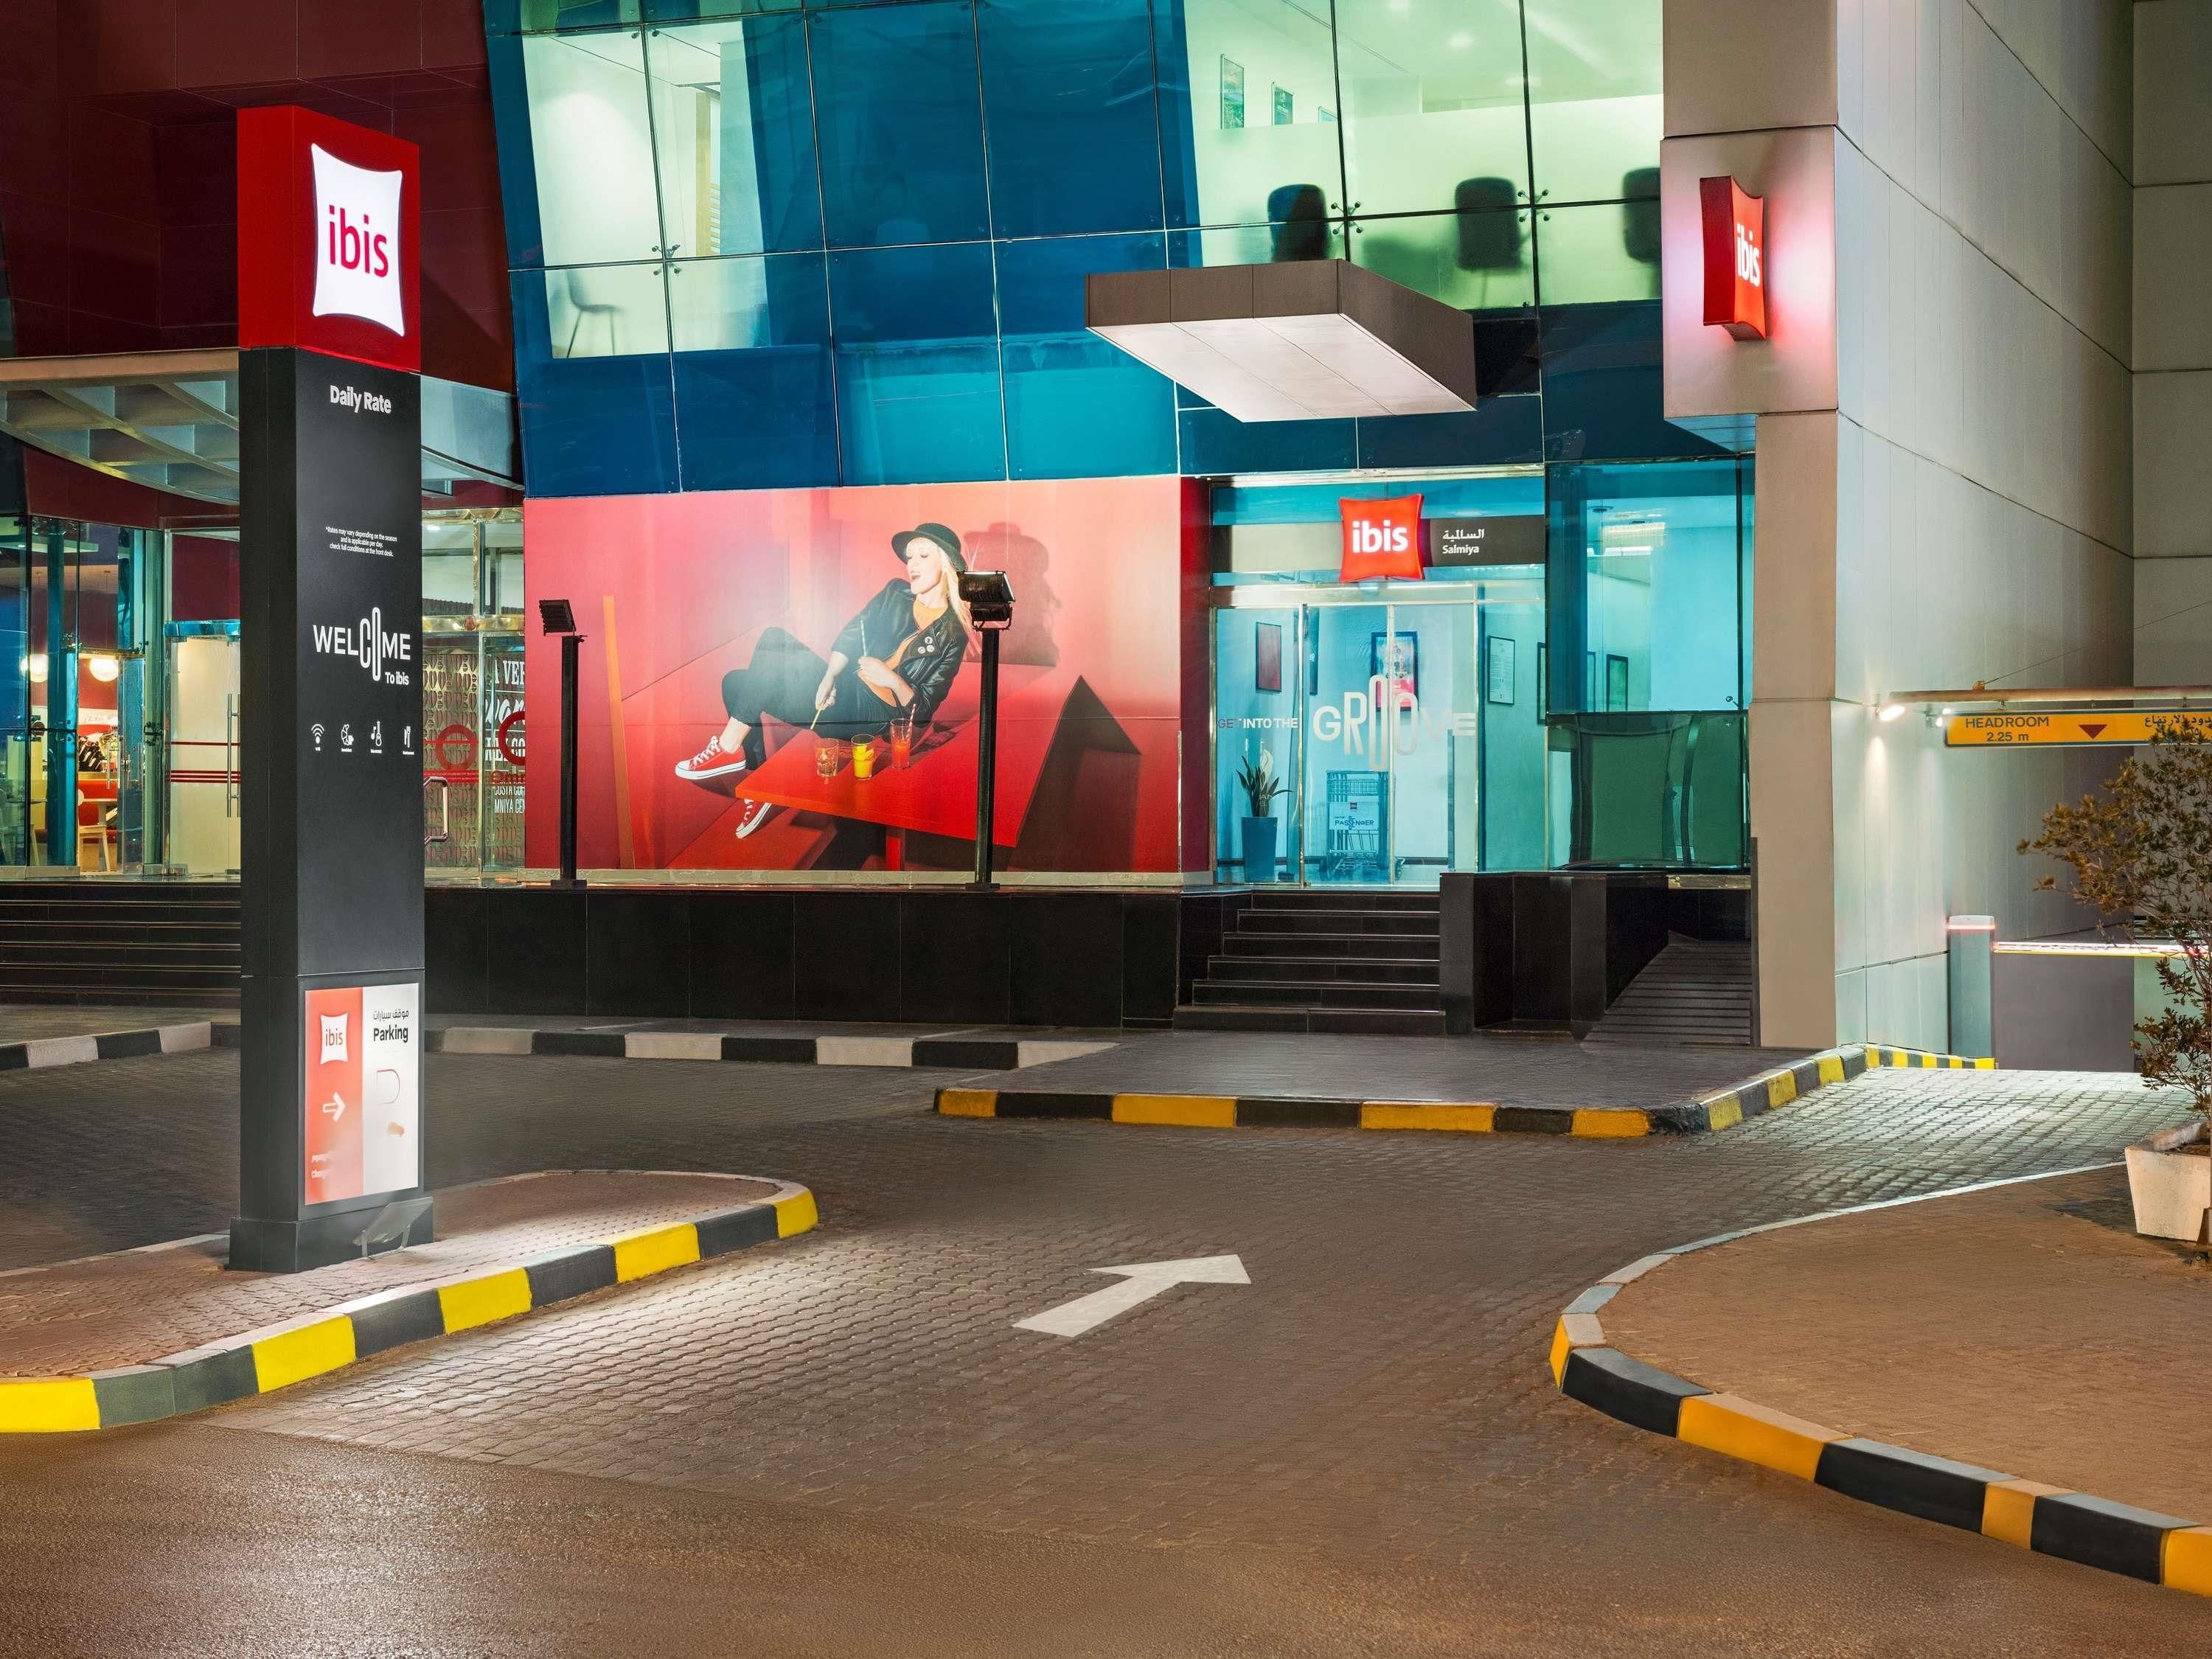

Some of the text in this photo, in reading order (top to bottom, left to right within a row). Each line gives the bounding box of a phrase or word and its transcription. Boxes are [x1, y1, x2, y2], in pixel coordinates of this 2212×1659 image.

[329, 204, 389, 278] ibis
[1736, 222, 1761, 288] ibis
[330, 384, 392, 414] Daily Rate
[1352, 519, 1409, 553] ibis
[1441, 545, 1480, 556] Salmiya
[313, 607, 411, 682] WELCOME
[385, 671, 409, 686] To ibis
[1243, 717, 1272, 729] INTO
[1273, 717, 1298, 729] THE
[1312, 675, 1476, 771] GROOVE
[1965, 716, 2050, 729] HEADROOM
[1986, 731, 2029, 742] 2.25 m
[325, 1028, 344, 1047] ibis
[373, 1023, 408, 1043] Parking
